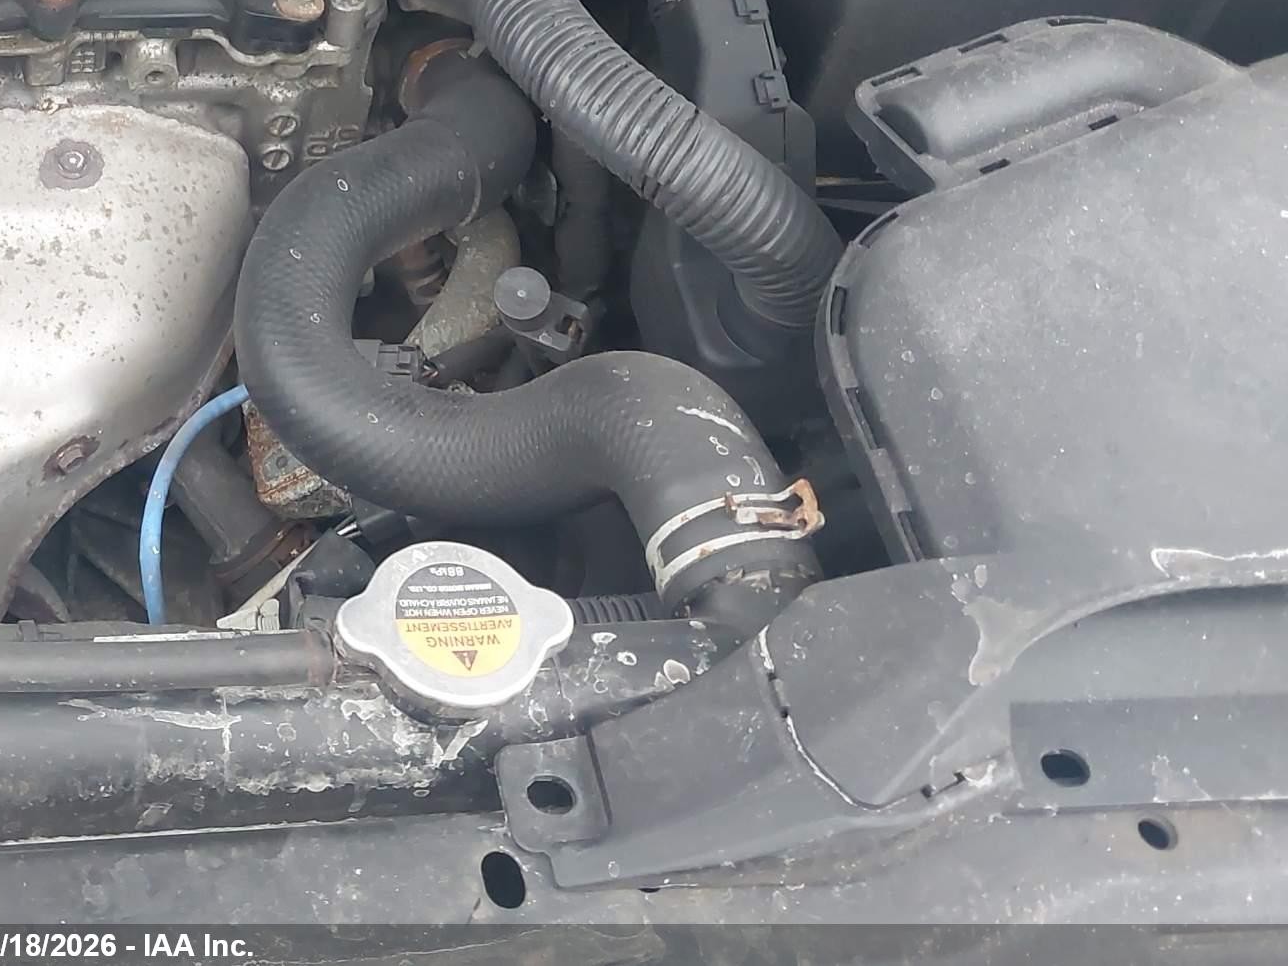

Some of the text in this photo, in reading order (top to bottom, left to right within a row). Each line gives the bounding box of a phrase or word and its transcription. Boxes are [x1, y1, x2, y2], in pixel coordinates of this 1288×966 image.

[430, 608, 453, 618] WHEN
[453, 607, 478, 616] OPEN
[479, 604, 509, 614] NEVER
[406, 619, 513, 633] AVERTISSEMENT
[426, 633, 501, 649] WARNING
